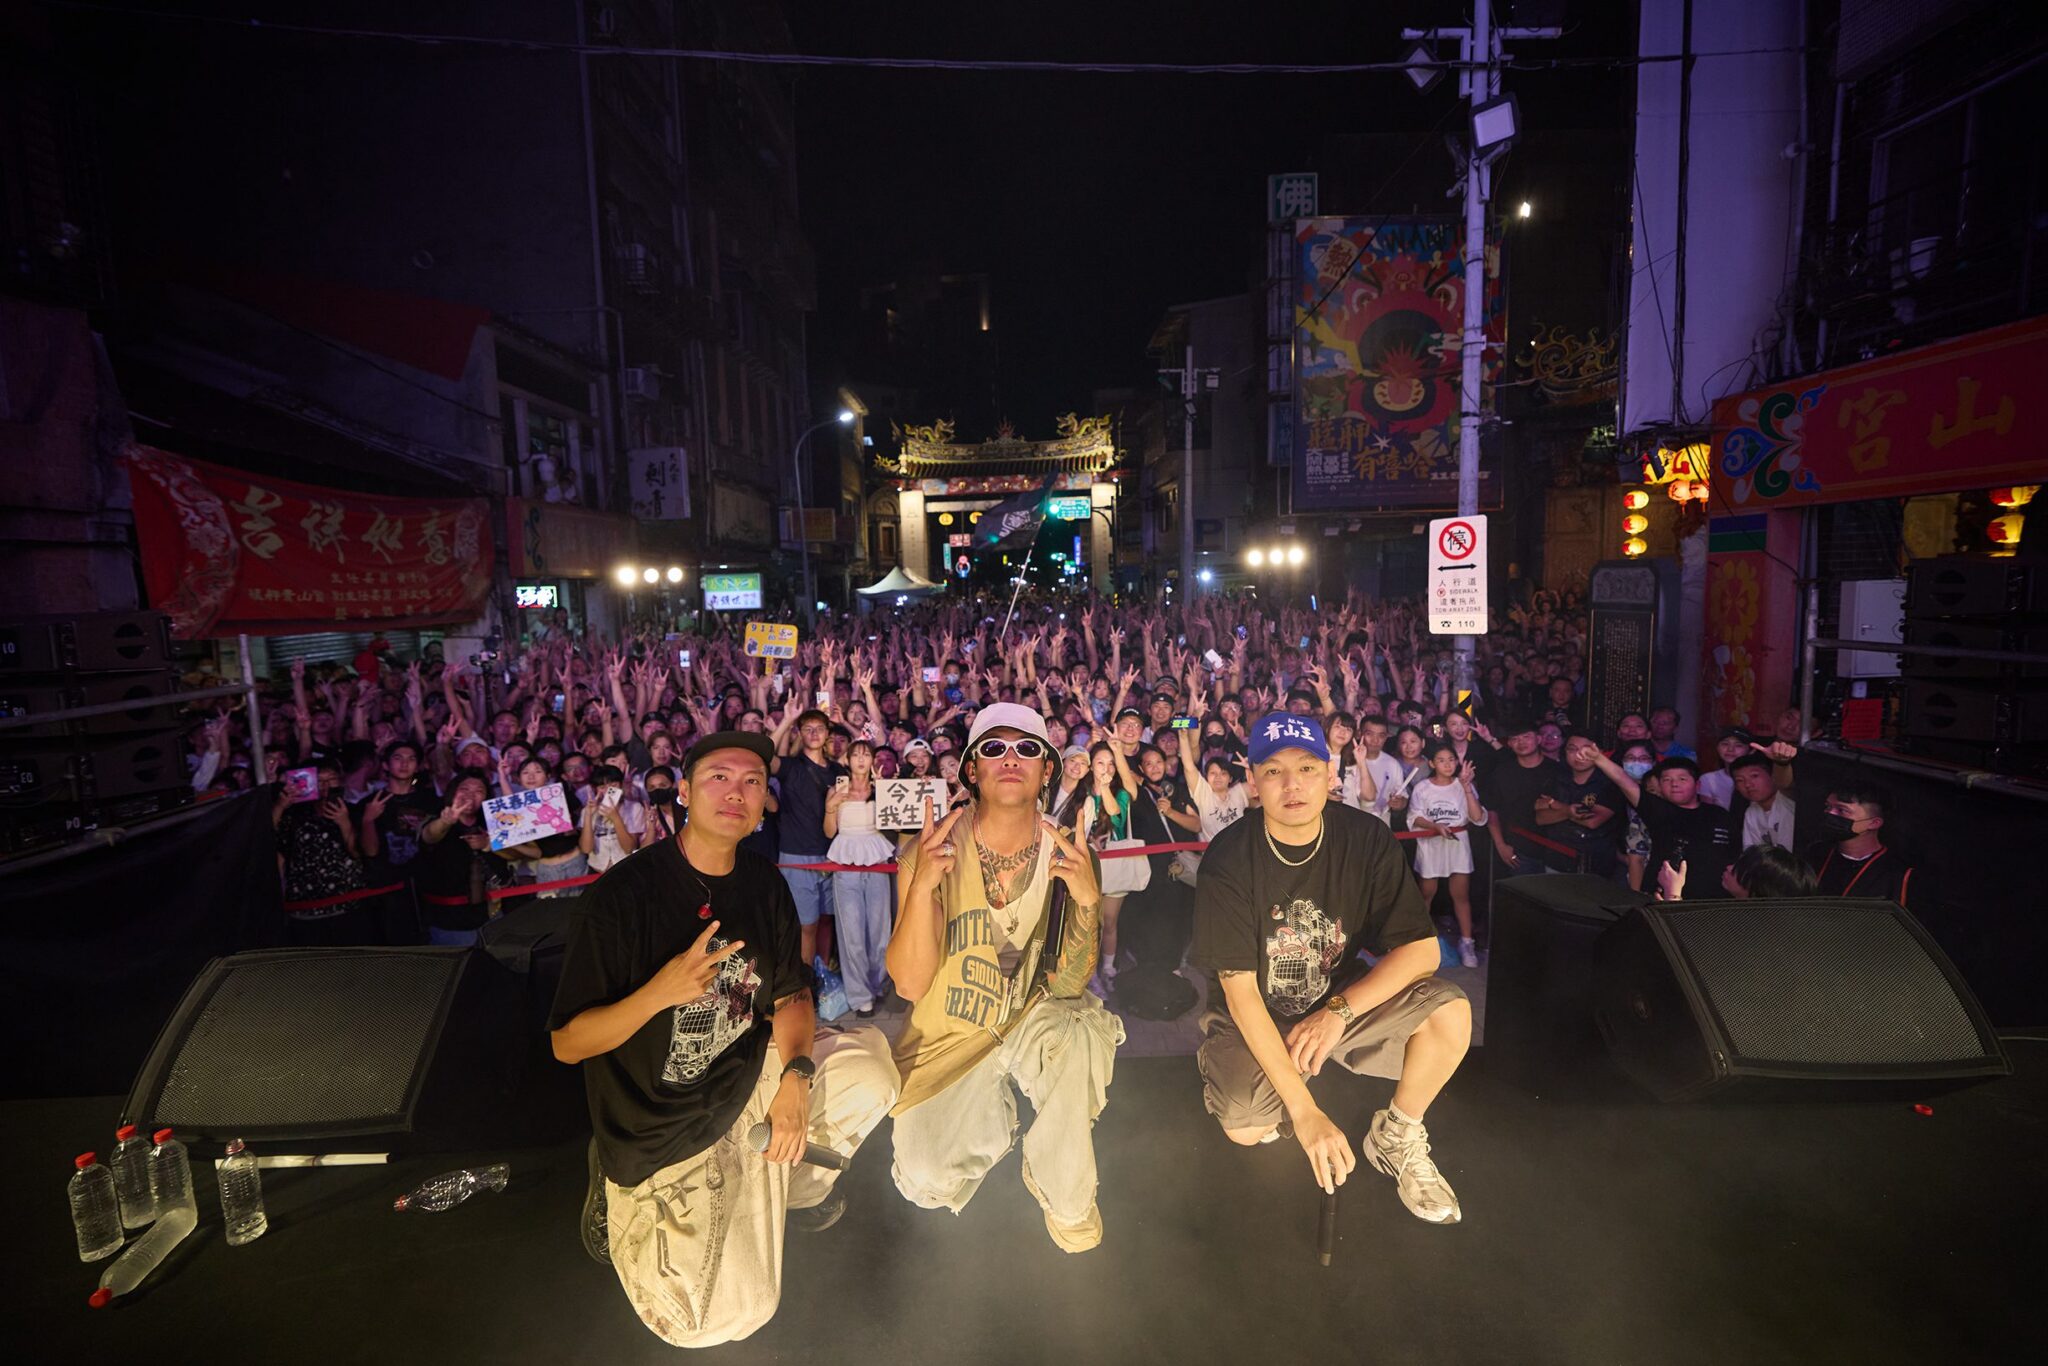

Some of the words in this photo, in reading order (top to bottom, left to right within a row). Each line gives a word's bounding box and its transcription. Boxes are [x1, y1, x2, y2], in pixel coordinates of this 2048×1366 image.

[1276, 179, 1313, 217] 佛
[1353, 446, 1437, 480] 有嘻哈
[645, 461, 666, 518] 刺青
[229, 485, 452, 566] 吉祥如意
[1447, 530, 1467, 551] 停
[1438, 577, 1477, 587] 人行道
[1458, 620, 1476, 628] 110
[934, 727, 945, 735] W
[1263, 721, 1316, 742] 青山王
[487, 790, 541, 814] 洪春風
[887, 781, 935, 803] 今天
[945, 985, 995, 1028] REAT
